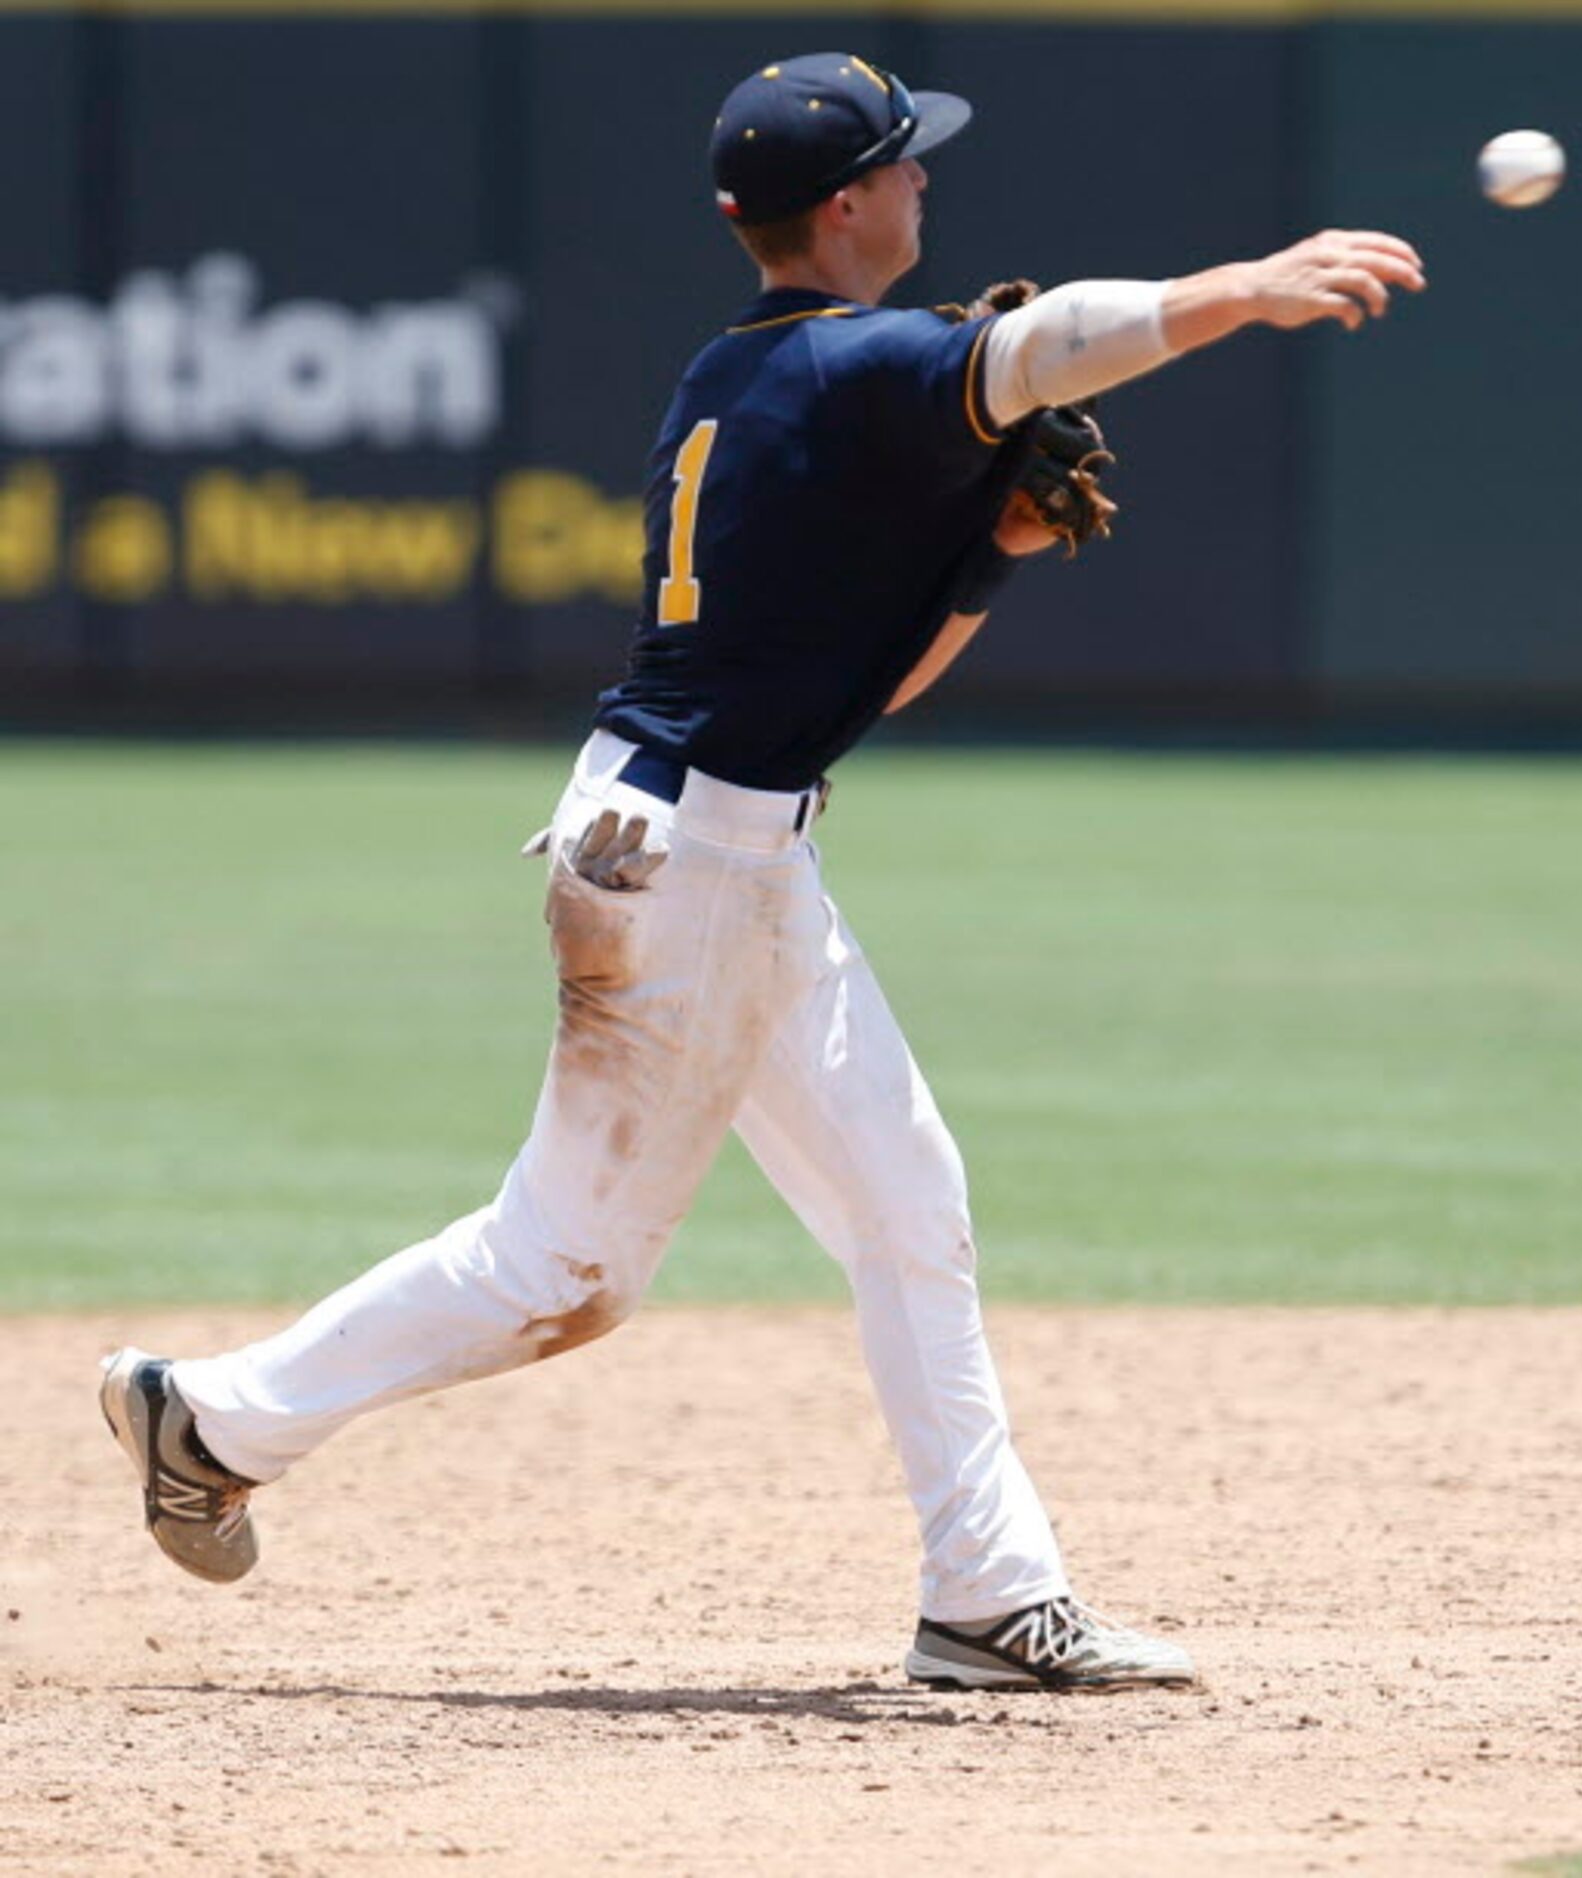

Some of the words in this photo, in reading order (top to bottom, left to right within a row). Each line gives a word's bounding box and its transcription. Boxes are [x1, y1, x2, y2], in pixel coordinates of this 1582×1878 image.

[0, 254, 496, 446] ation
[78, 499, 167, 600] a
[186, 472, 476, 600] New
[657, 419, 717, 626] 1
